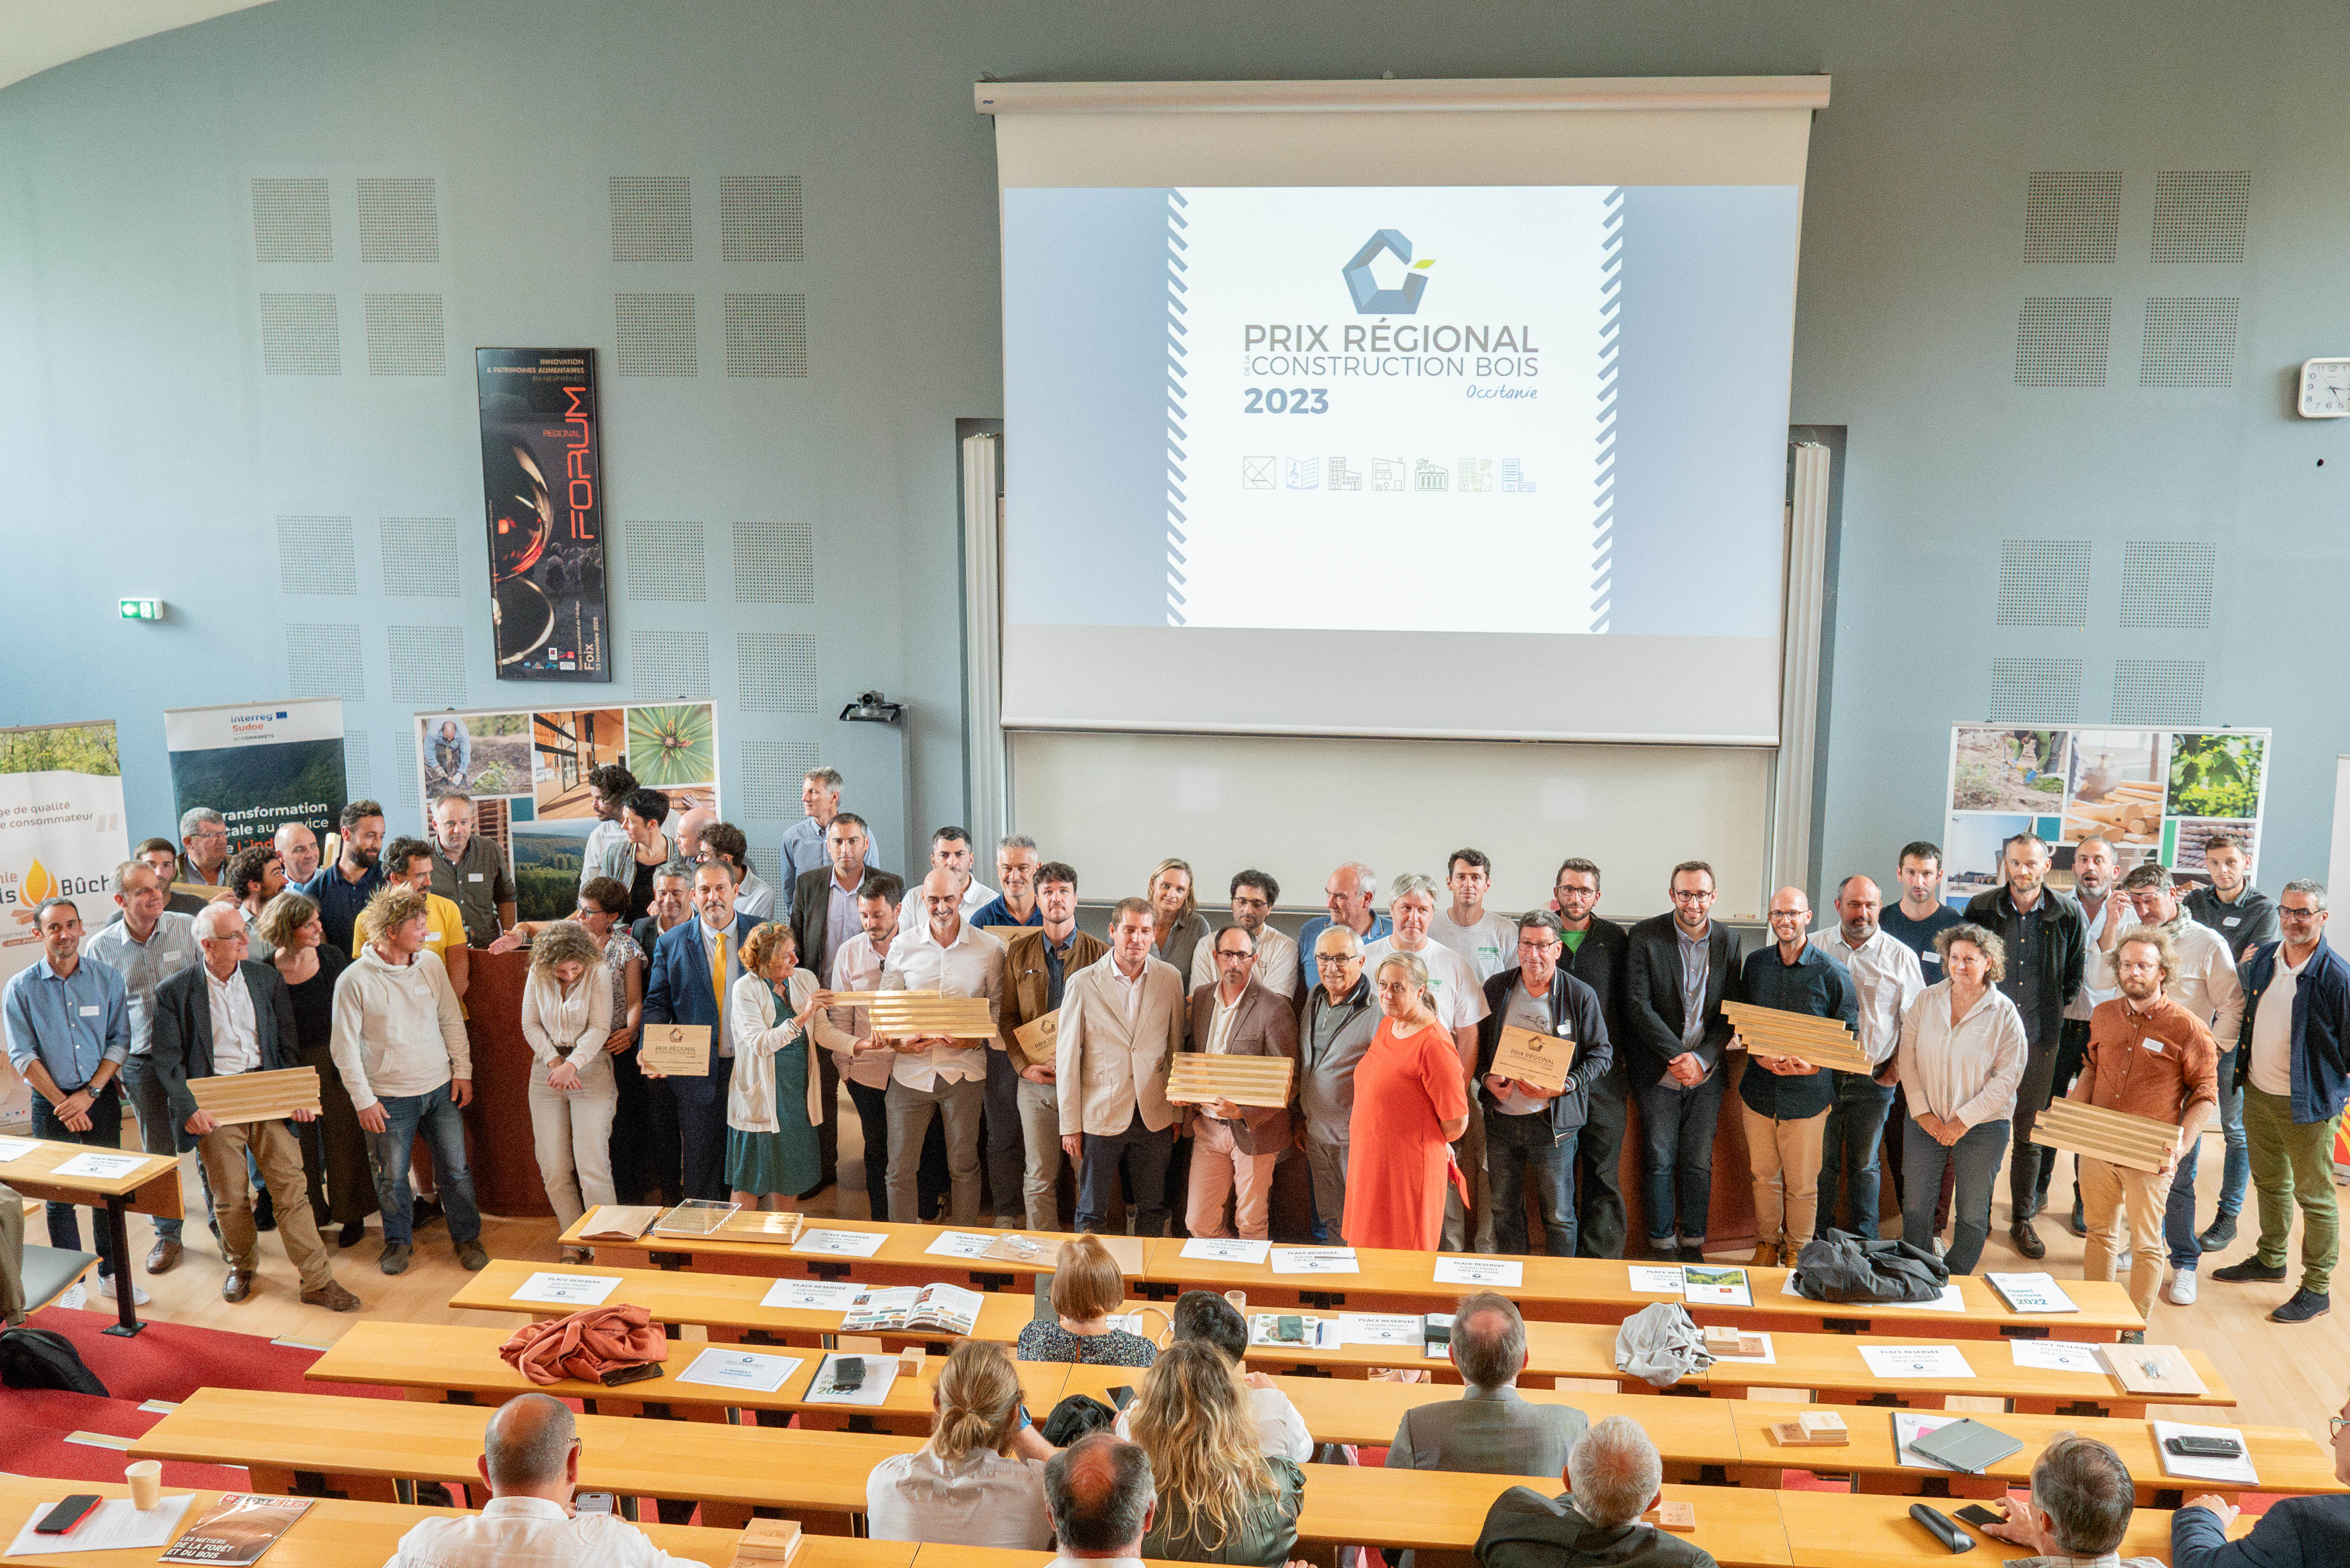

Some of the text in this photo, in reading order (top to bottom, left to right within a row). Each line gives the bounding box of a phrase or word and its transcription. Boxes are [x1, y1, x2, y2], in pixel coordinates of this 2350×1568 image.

[1245, 317, 1539, 352] PRIX RÉGIONAL
[1244, 355, 1250, 376] DE LA
[1252, 356, 1538, 377] CONSTRUCTION BOIS
[1466, 384, 1538, 400] Occitanie
[1245, 388, 1329, 414] 2023
[562, 386, 595, 540] FORUM
[584, 643, 595, 670] Foix
[231, 714, 272, 723] Interreg
[232, 724, 263, 732] Sudoe
[13, 806, 27, 814] de
[31, 801, 71, 814] qualité
[222, 802, 328, 821] ransformation
[10, 813, 93, 828] consommateur
[226, 824, 253, 837] tale
[258, 824, 274, 833] au
[61, 875, 110, 896] Bûch
[1526, 1053, 1554, 1064] RÉGIONAL
[194, 1536, 227, 1545] MÉTIERS
[203, 1544, 235, 1552] FORÊT
